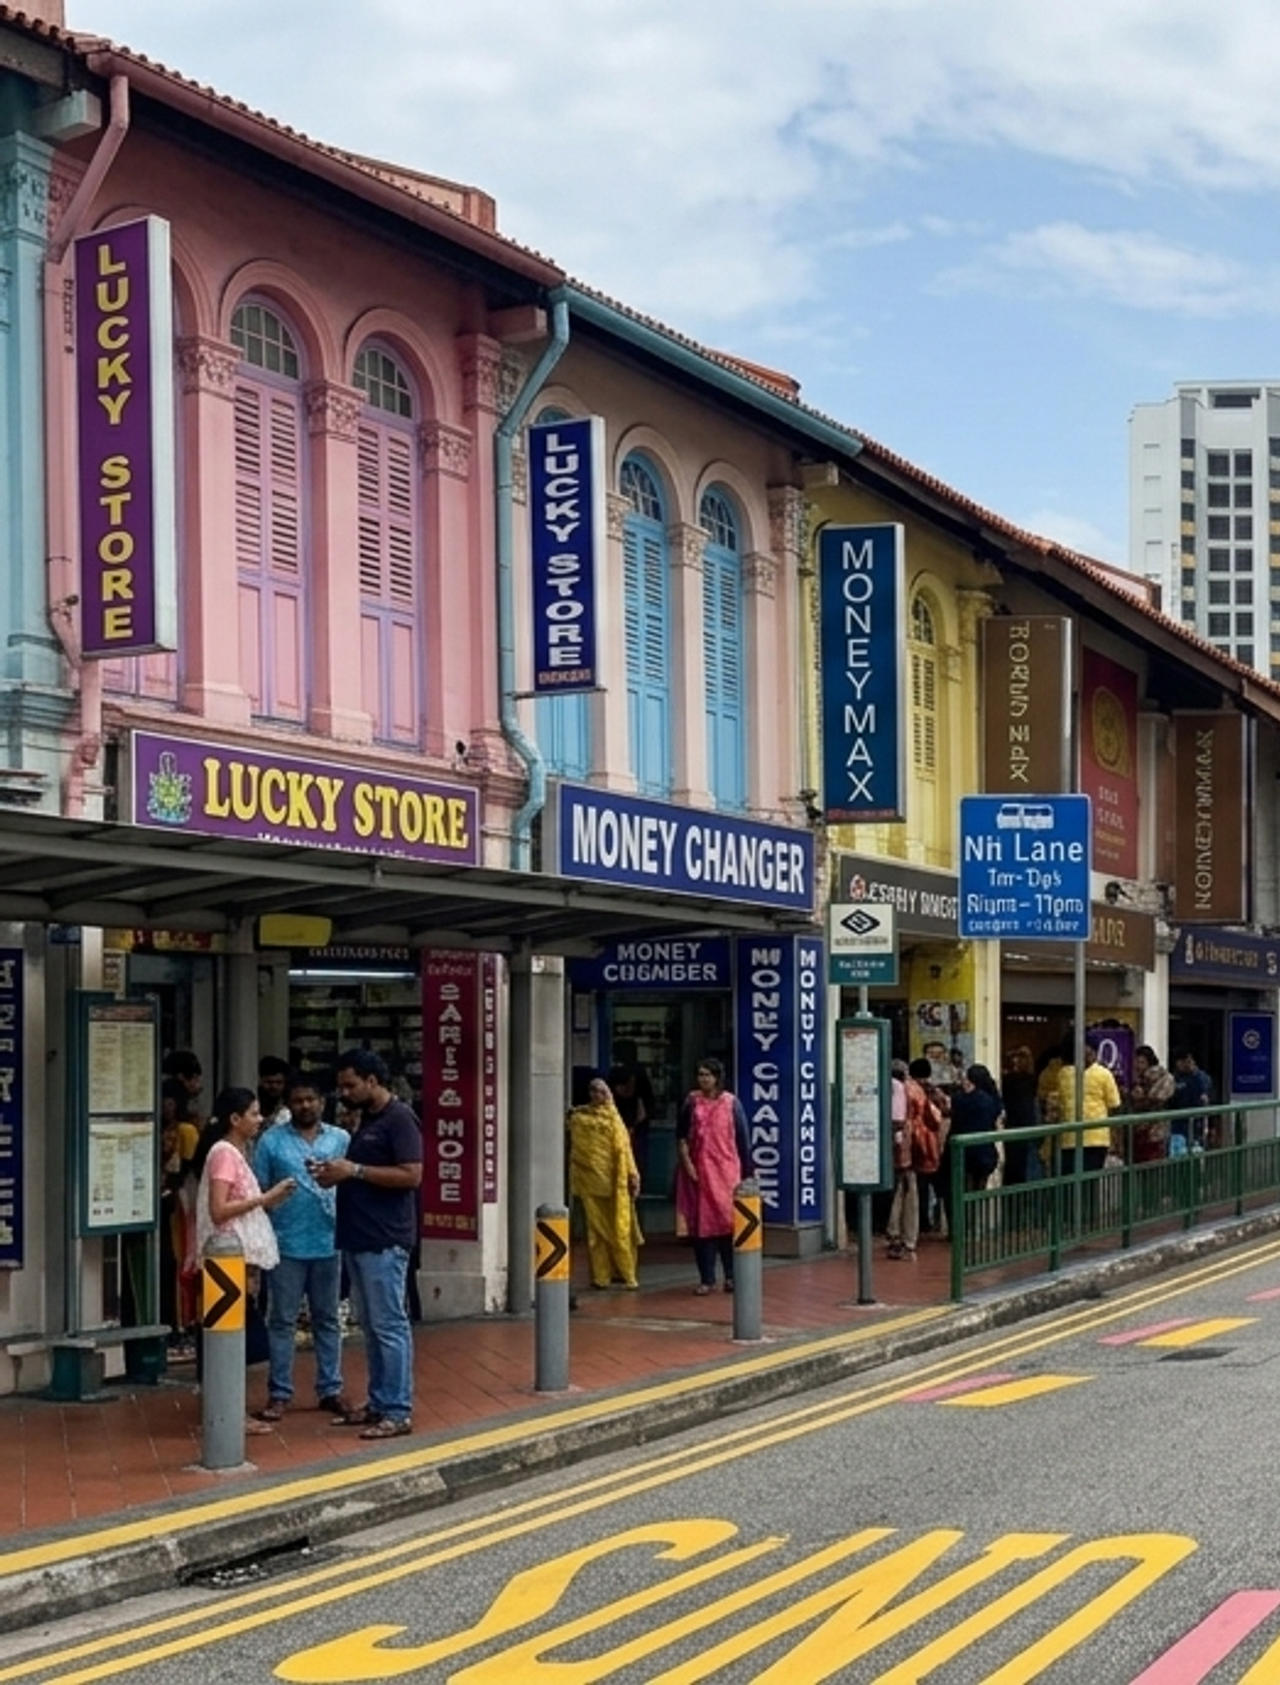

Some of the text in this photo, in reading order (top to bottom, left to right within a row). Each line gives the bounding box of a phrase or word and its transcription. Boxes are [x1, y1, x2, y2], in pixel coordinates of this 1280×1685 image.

[98, 243, 135, 640] LUCKY STORE
[545, 432, 580, 543] LUCKY
[546, 553, 585, 668] STORE
[842, 539, 876, 802] MONEYMAX
[203, 757, 469, 849] LUCKY STORE
[572, 803, 805, 894] MONEY CHANGER
[1015, 832, 1083, 862] Lane
[617, 942, 701, 961] MONEY
